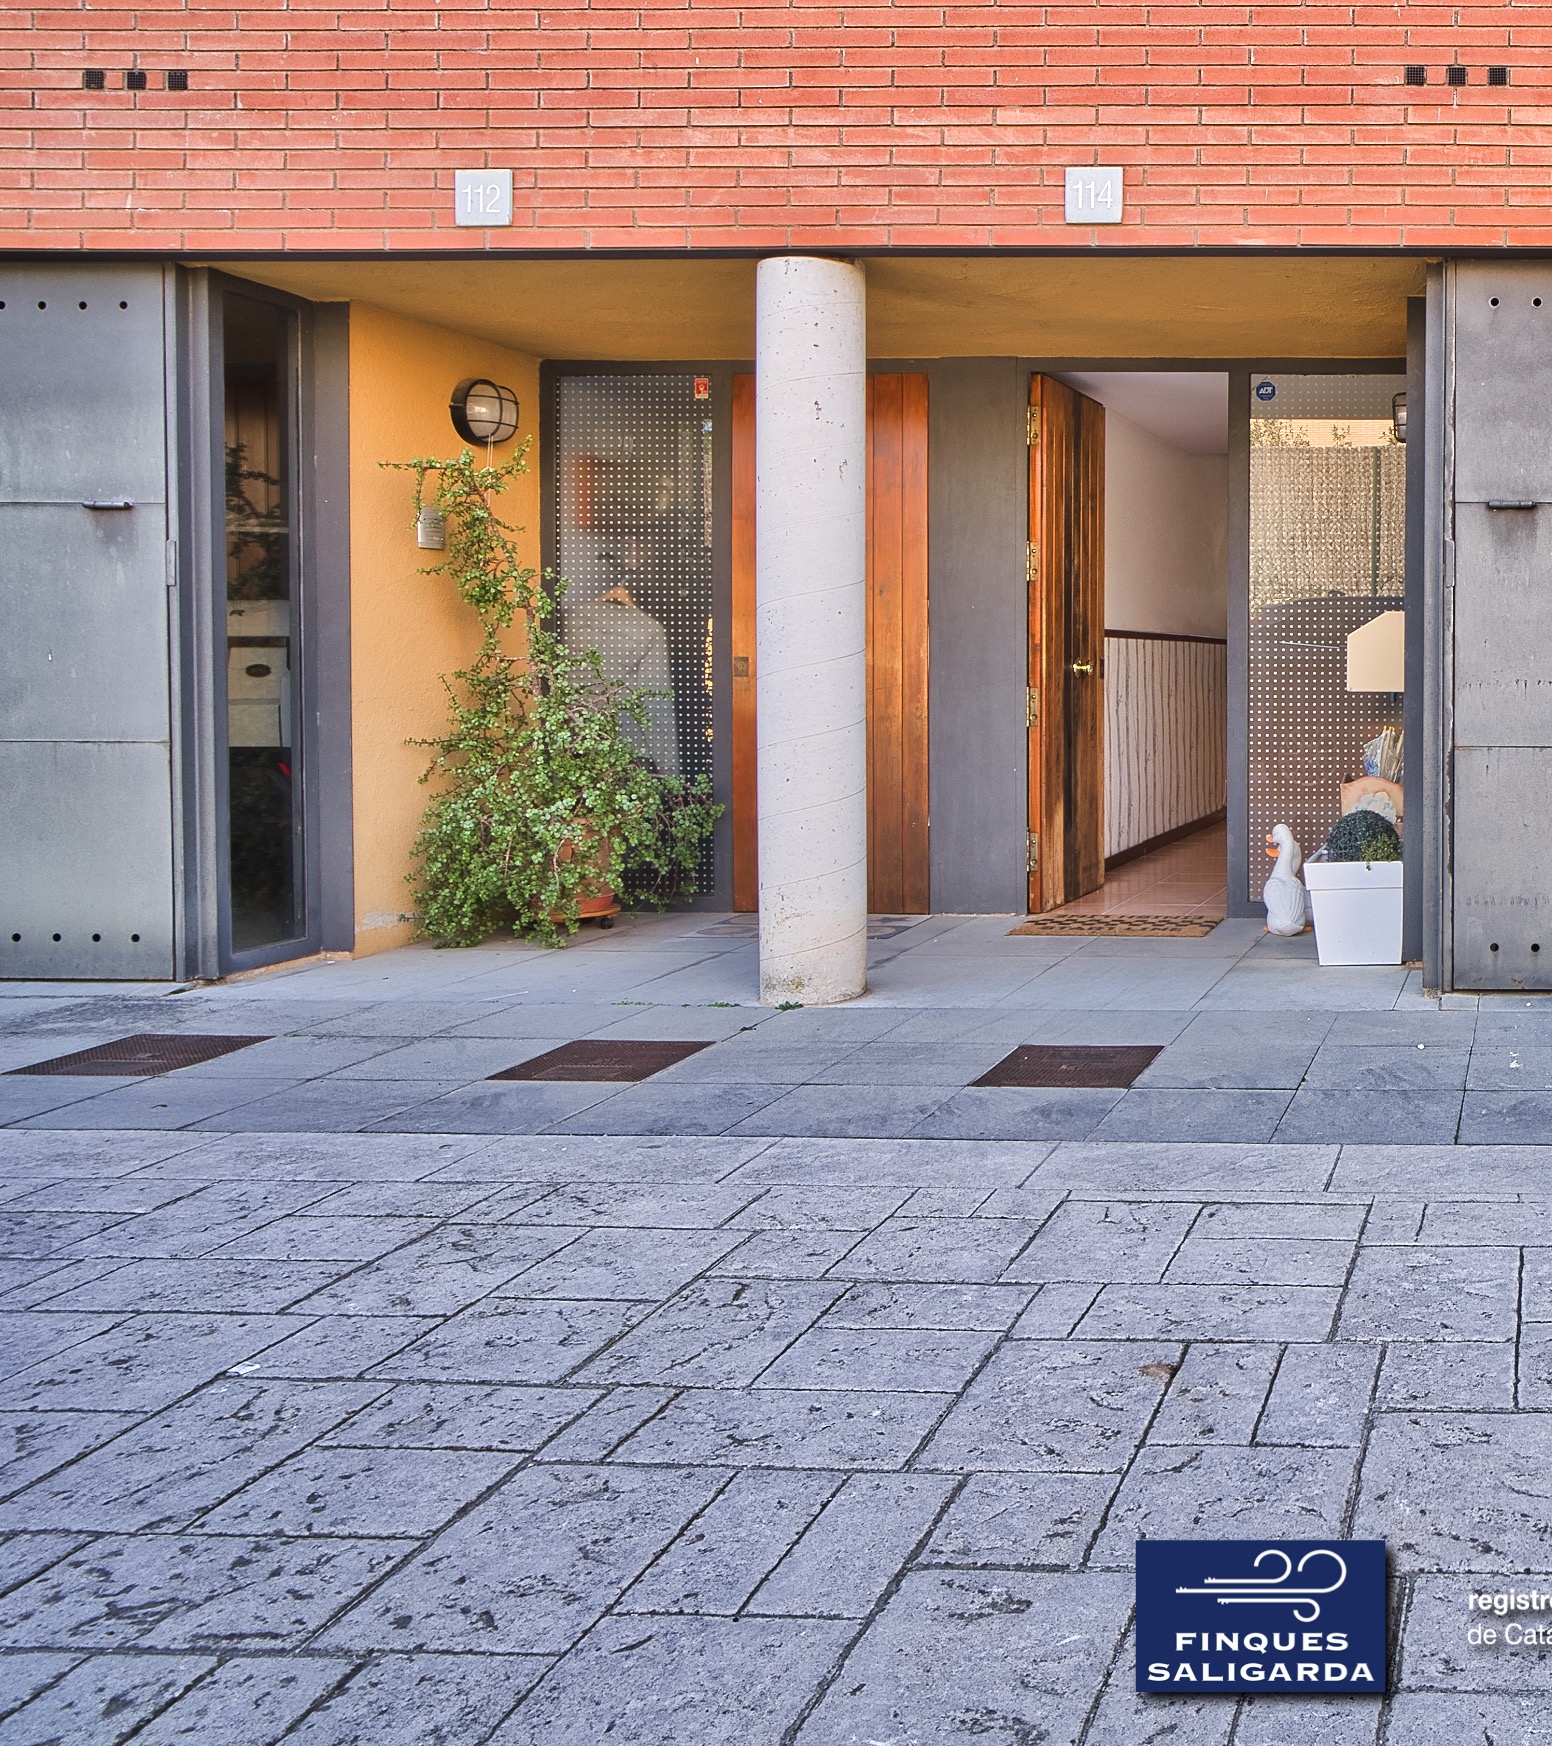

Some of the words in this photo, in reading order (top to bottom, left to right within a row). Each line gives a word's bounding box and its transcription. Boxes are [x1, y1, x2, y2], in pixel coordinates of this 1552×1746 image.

[461, 184, 501, 213] 112
[1072, 180, 1114, 209] 114
[1259, 386, 1273, 394] ADT
